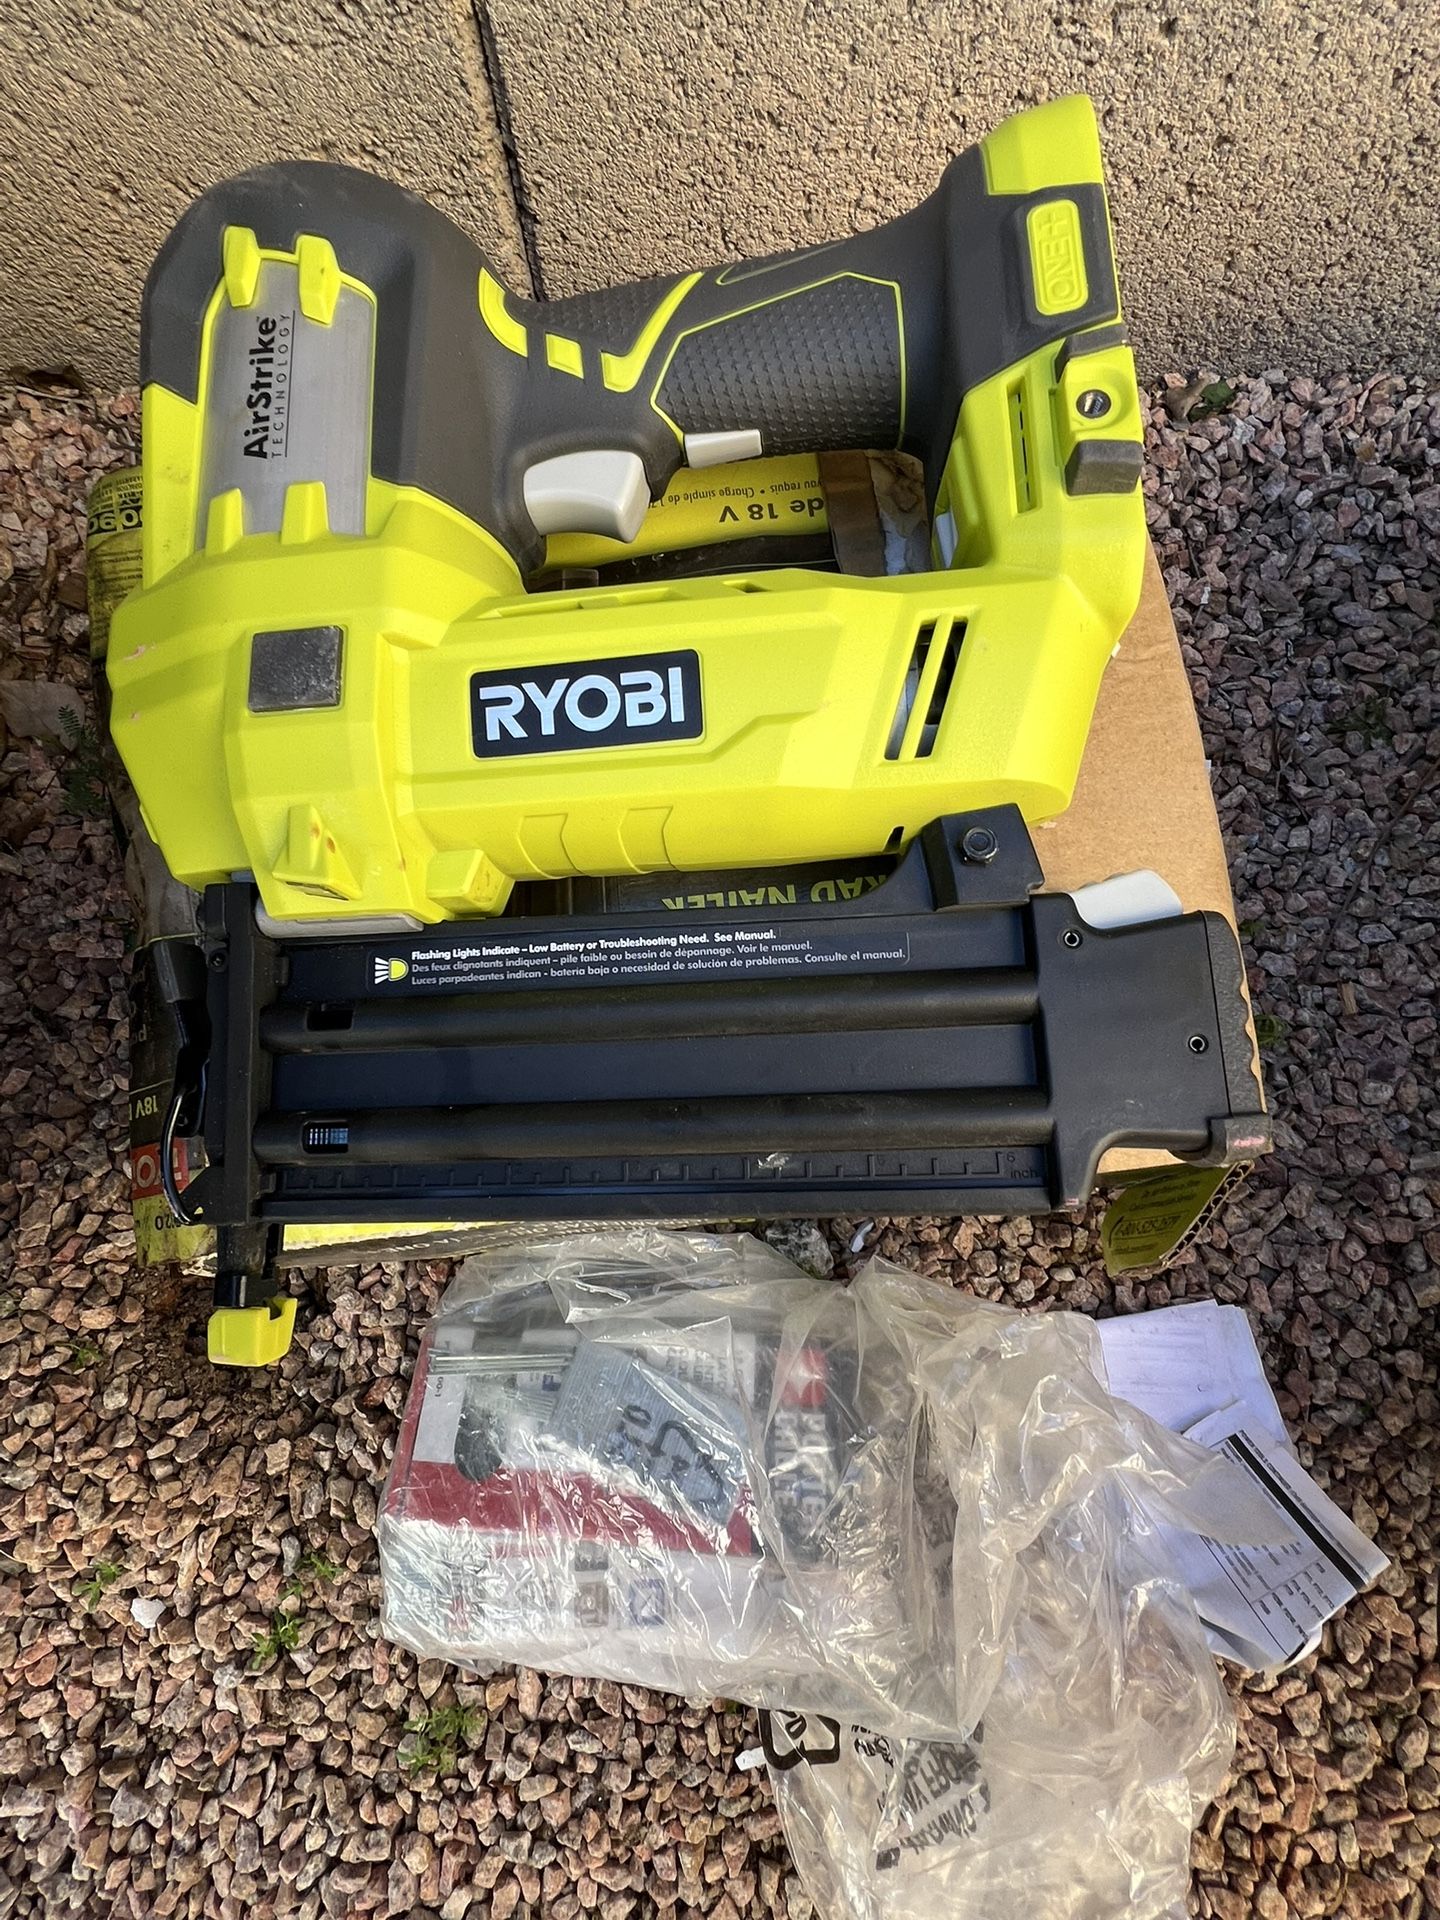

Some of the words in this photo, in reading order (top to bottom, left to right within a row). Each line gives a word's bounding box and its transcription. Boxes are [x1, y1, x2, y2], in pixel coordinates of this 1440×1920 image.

[271, 314, 291, 459] TECHNOLOGY
[683, 489, 716, 504] simple
[718, 486, 755, 499] Charge
[769, 482, 800, 495] requis
[718, 504, 740, 523] V
[746, 502, 779, 521] 18
[789, 497, 824, 517] de
[479, 666, 686, 742] RYOBI
[411, 948, 451, 961] Flashing
[452, 946, 481, 959] Lights
[482, 944, 520, 957] Indicate
[528, 942, 549, 953] Low
[550, 942, 585, 952] Battery
[586, 941, 598, 950] or
[598, 935, 678, 949] Troubleshooting
[679, 933, 710, 945] Need.
[714, 932, 733, 942] See
[734, 929, 777, 941] Manual.
[412, 963, 429, 973] Des
[431, 961, 451, 972] feux
[505, 956, 551, 969] indiquent
[560, 954, 578, 965] pile
[580, 952, 607, 963] faible
[609, 953, 623, 961] ou
[624, 949, 657, 960] besoin
[659, 948, 672, 958] de
[737, 944, 757, 953] Voir
[759, 943, 769, 952] le
[771, 940, 813, 951] manuel.
[411, 975, 437, 985] Luces
[438, 971, 505, 986] parpadeantes
[506, 969, 542, 980] indican
[587, 965, 610, 976] baja
[611, 966, 619, 974] o
[620, 962, 670, 973] necesidad
[672, 961, 685, 970] de
[687, 958, 728, 970] solución
[729, 957, 743, 967] de
[745, 955, 802, 968] problemas.
[804, 951, 848, 963] Consulte
[850, 950, 860, 961] el
[862, 948, 906, 960] manual.
